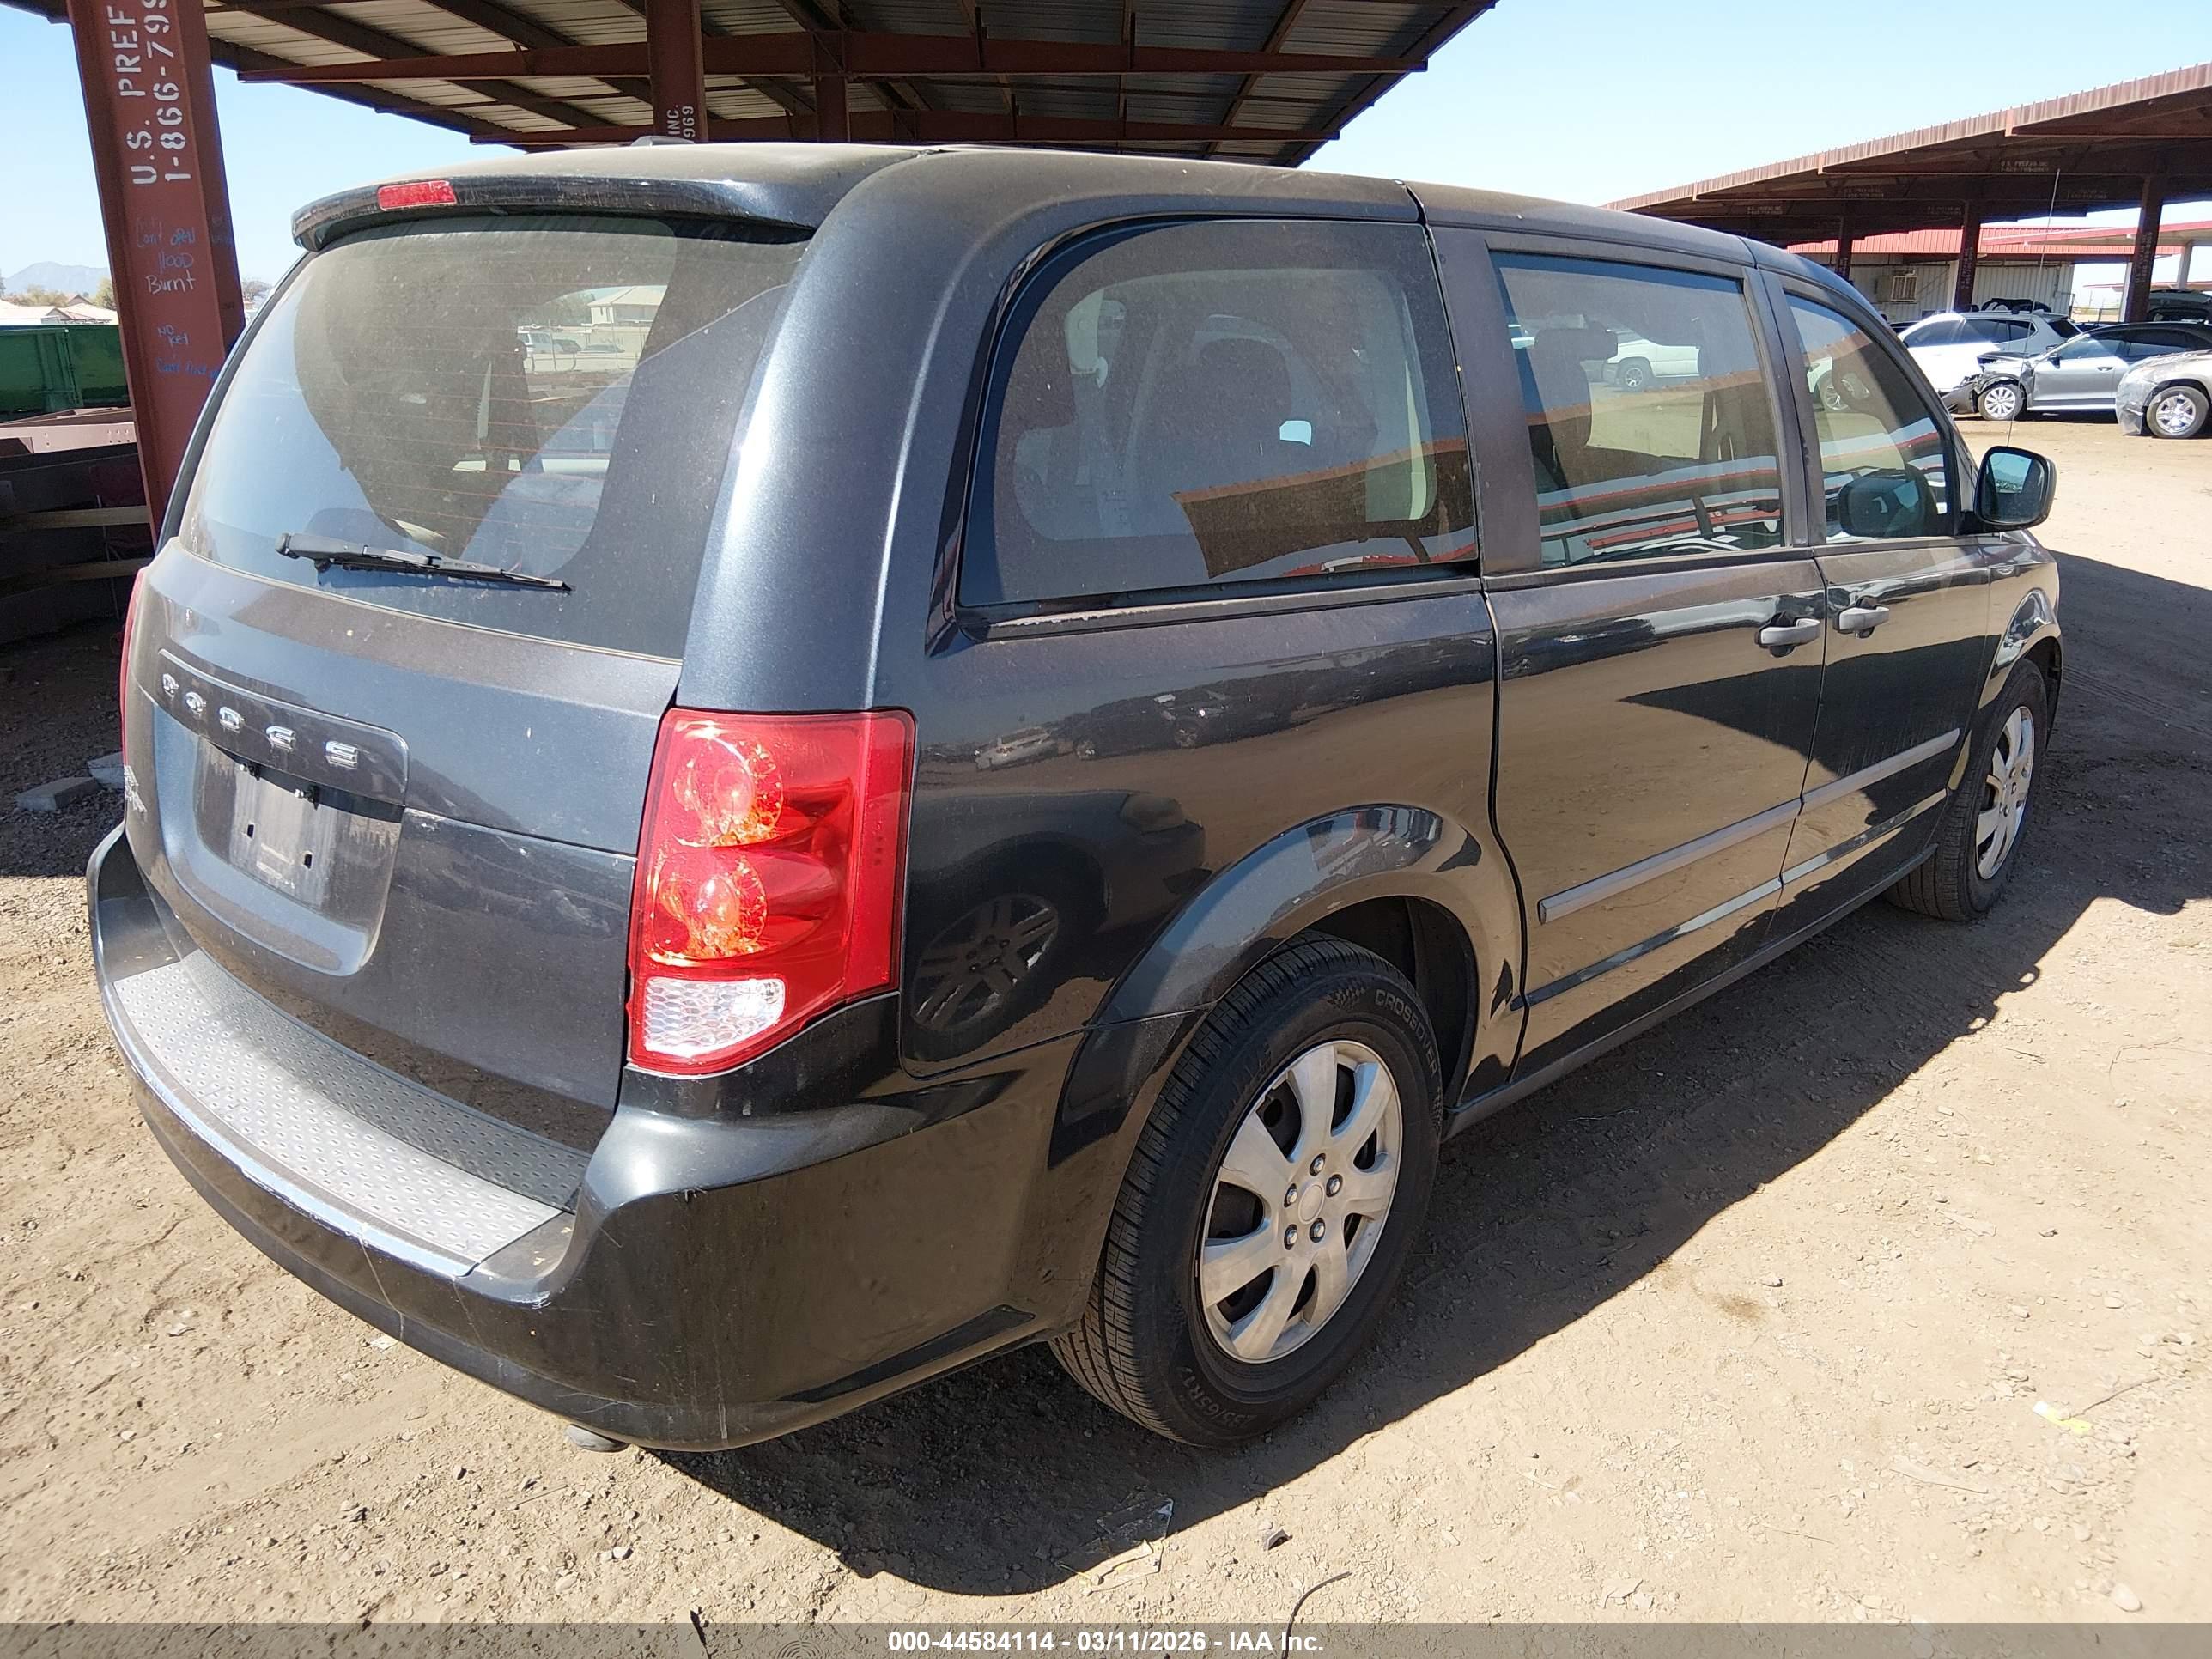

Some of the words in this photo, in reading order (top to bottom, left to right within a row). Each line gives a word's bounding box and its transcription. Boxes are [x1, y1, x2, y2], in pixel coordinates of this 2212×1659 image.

[125, 119, 157, 185] U.S.
[666, 104, 681, 135] INC.
[145, 269, 197, 294] Burnt
[161, 672, 359, 770] DODGE
[1375, 988, 1437, 1079] CROSSOVER
